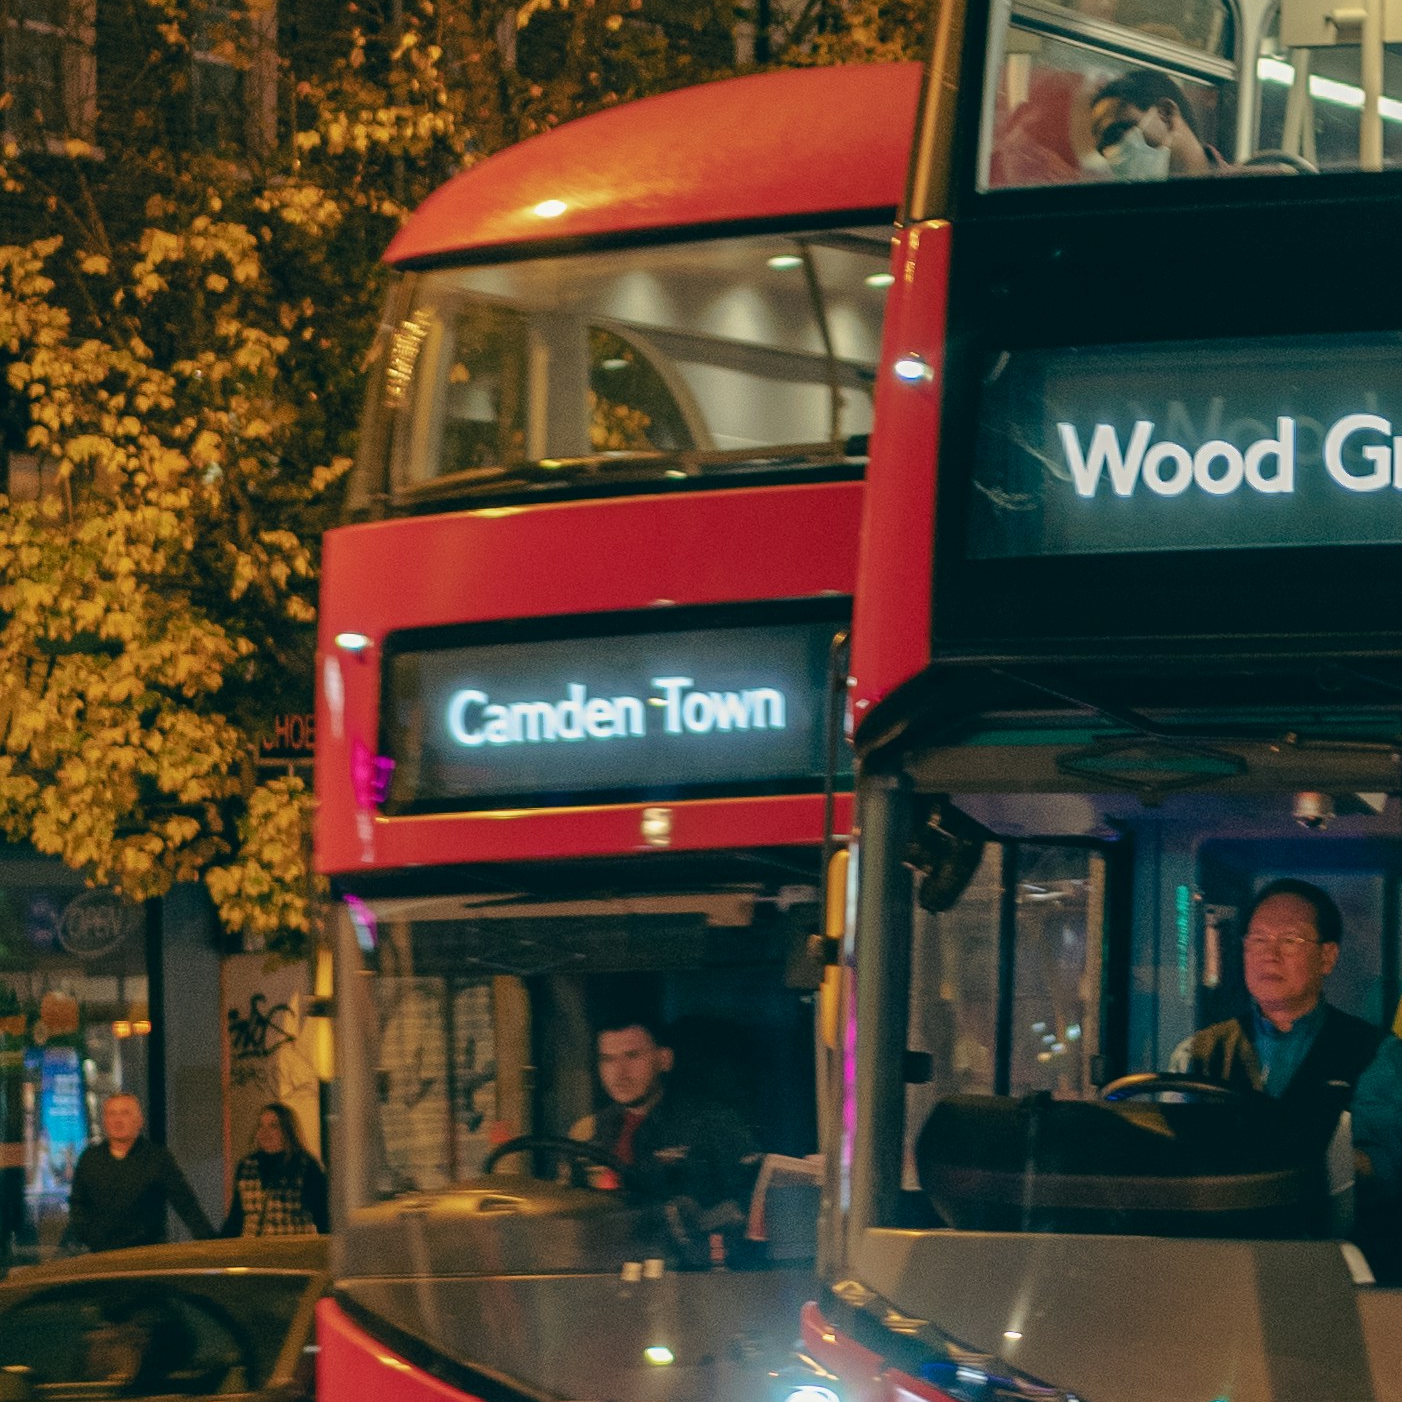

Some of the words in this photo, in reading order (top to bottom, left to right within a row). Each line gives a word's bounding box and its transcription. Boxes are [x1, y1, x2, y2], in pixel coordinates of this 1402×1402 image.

[1056, 415, 1296, 499] Wood
[447, 682, 646, 747] Camden
[652, 676, 786, 734] Town
